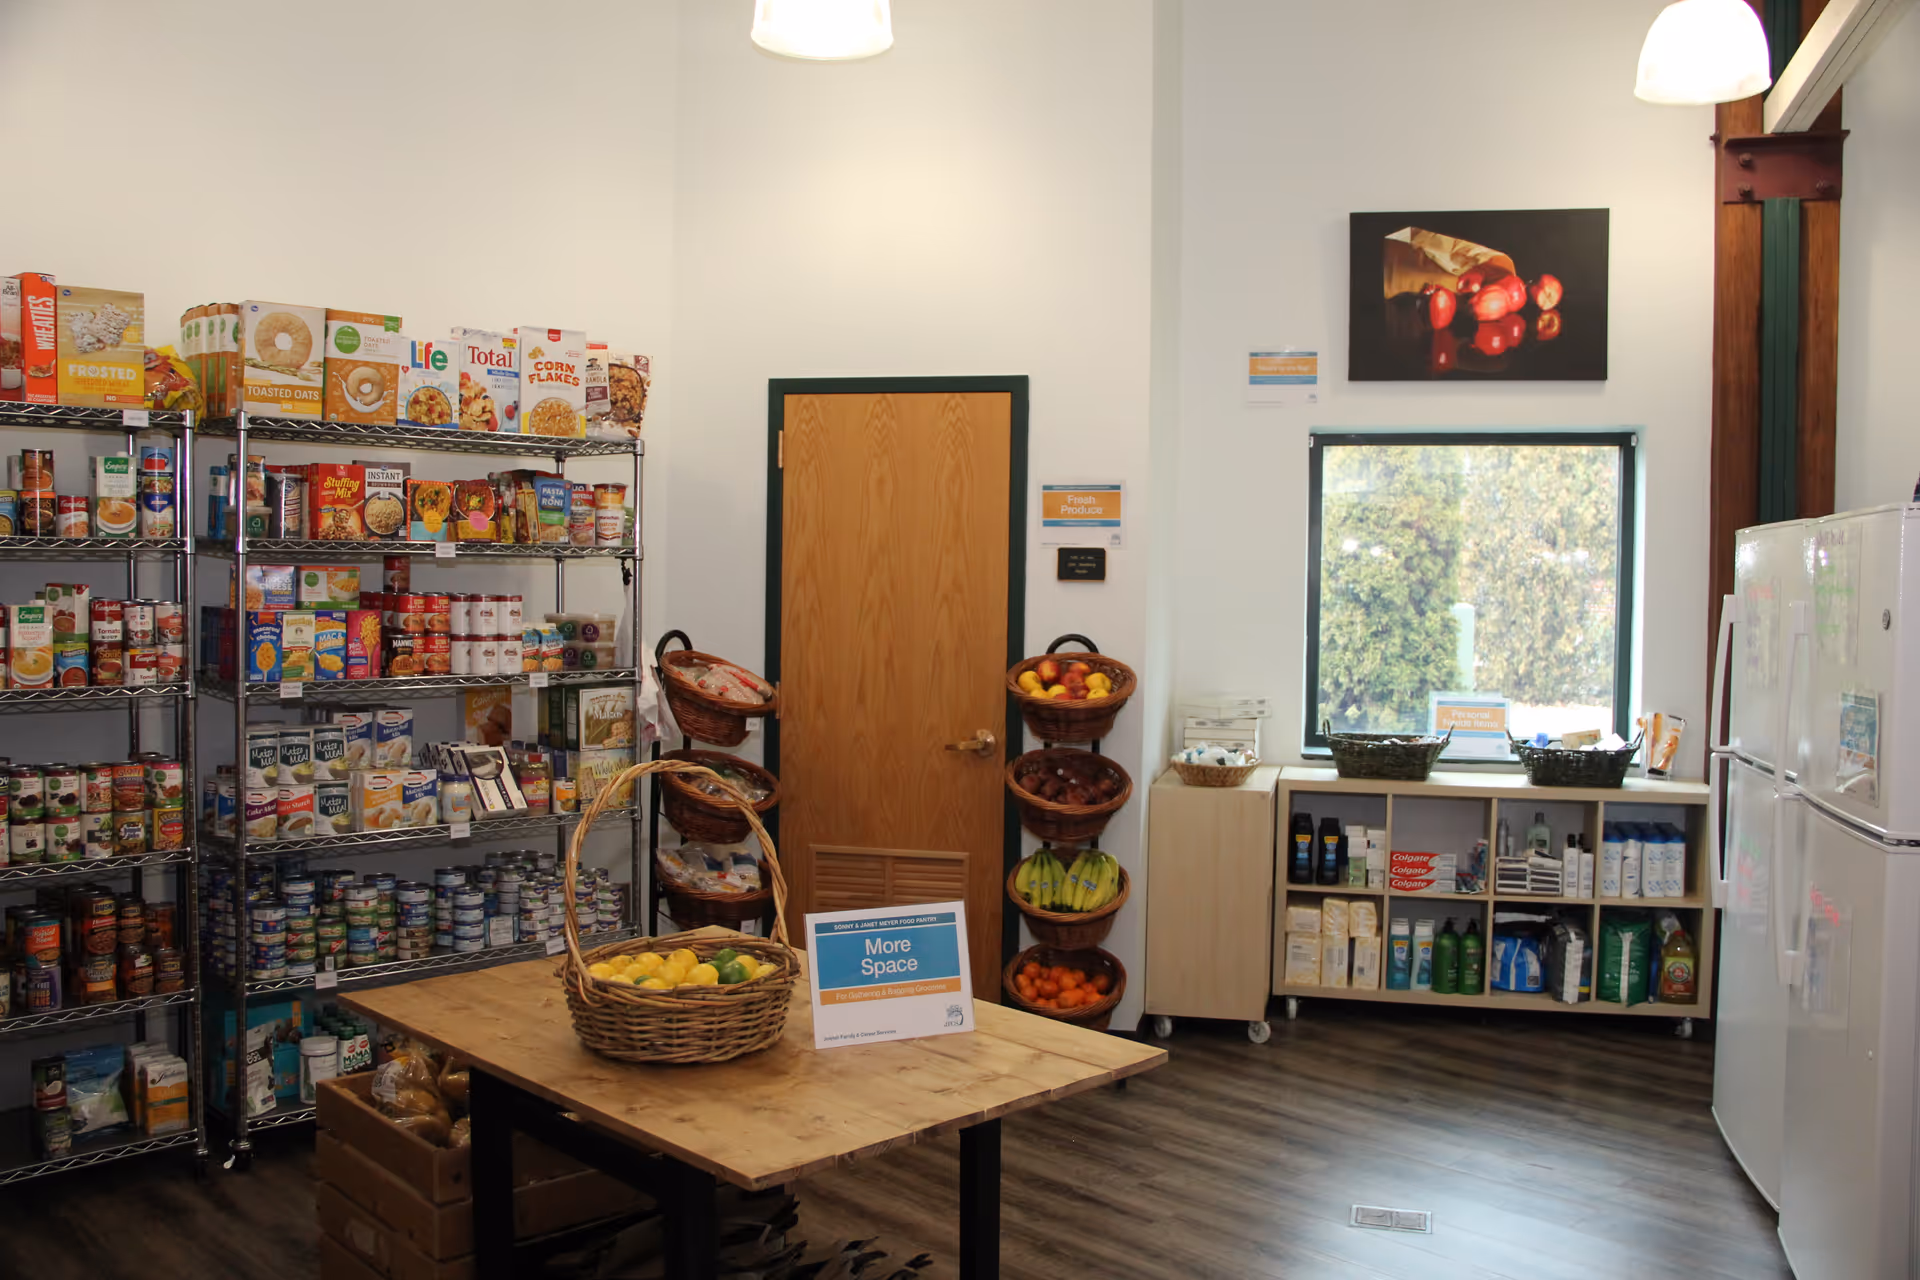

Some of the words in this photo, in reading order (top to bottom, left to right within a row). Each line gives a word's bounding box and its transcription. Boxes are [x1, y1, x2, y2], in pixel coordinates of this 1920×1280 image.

[28, 296, 55, 350] WHEATIES
[467, 345, 513, 368] Total
[68, 364, 137, 381] FROSTED
[533, 361, 576, 374] CORN
[528, 372, 581, 387] FLAKES
[248, 386, 292, 398] TOASTED
[294, 389, 320, 400] OATS
[367, 471, 401, 480] INSTANT
[324, 476, 360, 492] Stuffing
[334, 487, 352, 498] Mix
[542, 487, 564, 496] PASTA
[1067, 495, 1096, 505] Fresh
[1060, 504, 1103, 515] Produce
[319, 634, 336, 642] MAC
[1452, 709, 1490, 719] Personal
[316, 741, 338, 752] Matzo
[290, 749, 309, 764] Meal
[325, 745, 344, 760] Meal
[320, 796, 342, 807] Matzo
[328, 799, 347, 815] Meal
[1392, 853, 1430, 863] Colgate
[1391, 865, 1427, 874] Colgate
[1391, 879, 1427, 888] Colgate
[864, 938, 912, 956] More
[861, 958, 919, 978] Space
[835, 993, 848, 1001] For
